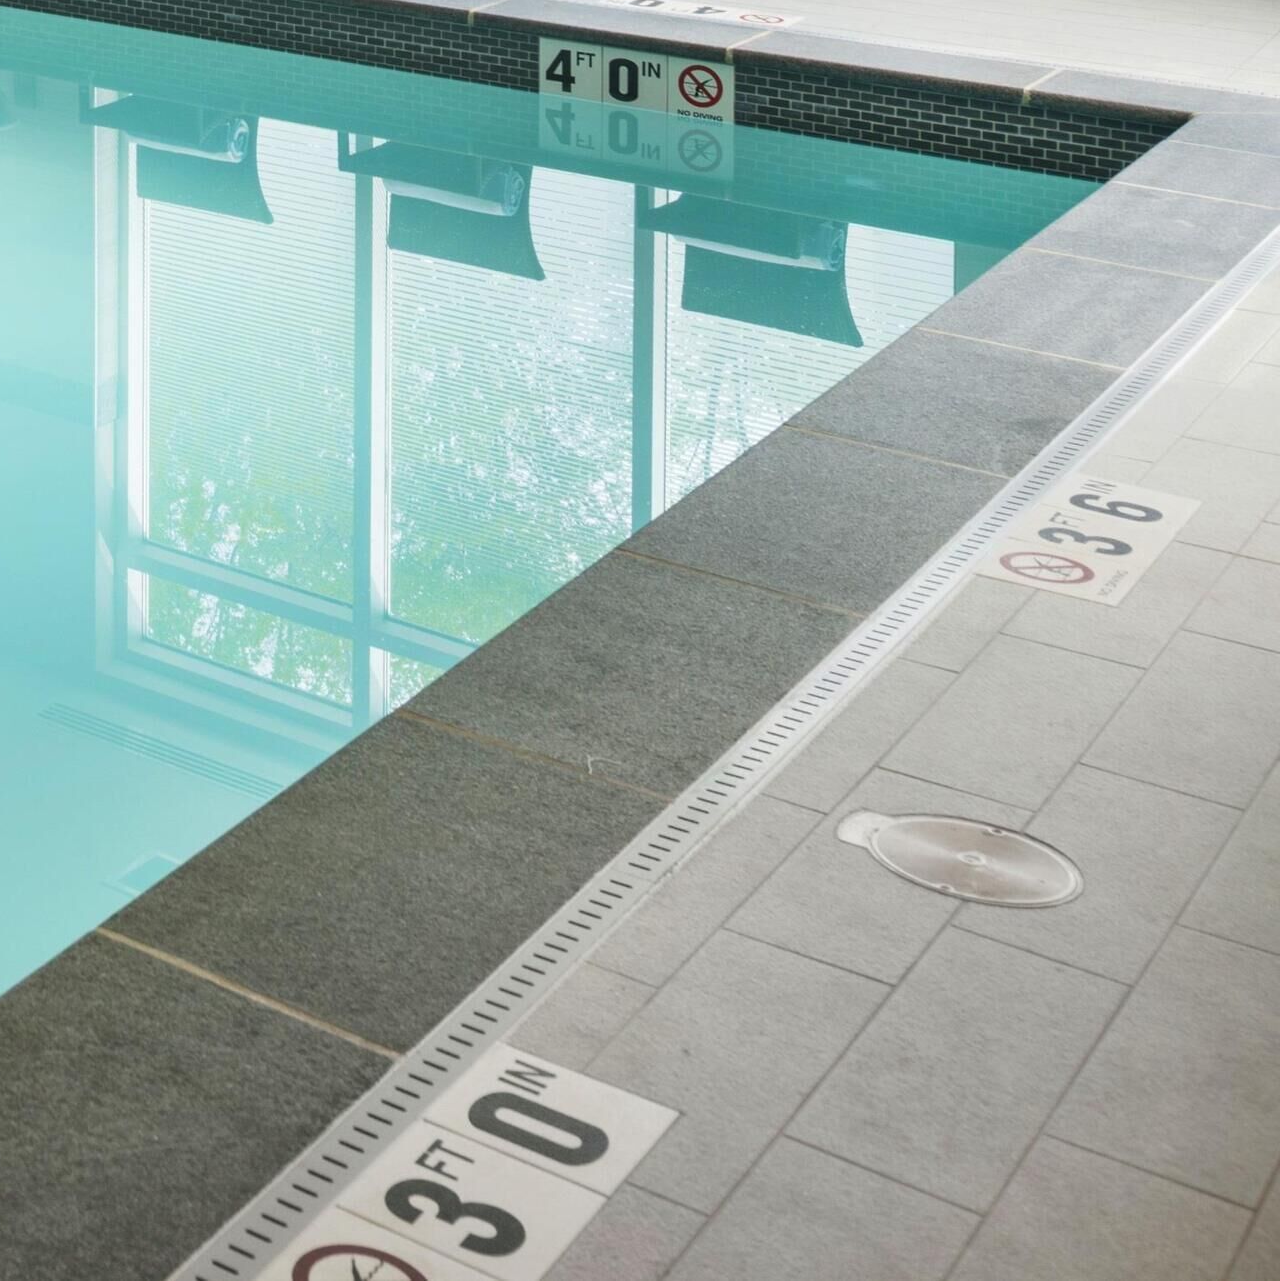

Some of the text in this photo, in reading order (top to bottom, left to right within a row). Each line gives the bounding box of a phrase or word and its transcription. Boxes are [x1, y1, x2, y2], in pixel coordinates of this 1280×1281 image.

[546, 49, 661, 102] 4 FT 0 IN
[693, 112, 723, 121] DIVING
[1081, 479, 1117, 494] IN
[1050, 512, 1085, 527] FT
[1070, 494, 1163, 522] 6
[1038, 527, 1132, 555] 3
[385, 1059, 609, 1257] 3 FT 0 IN
